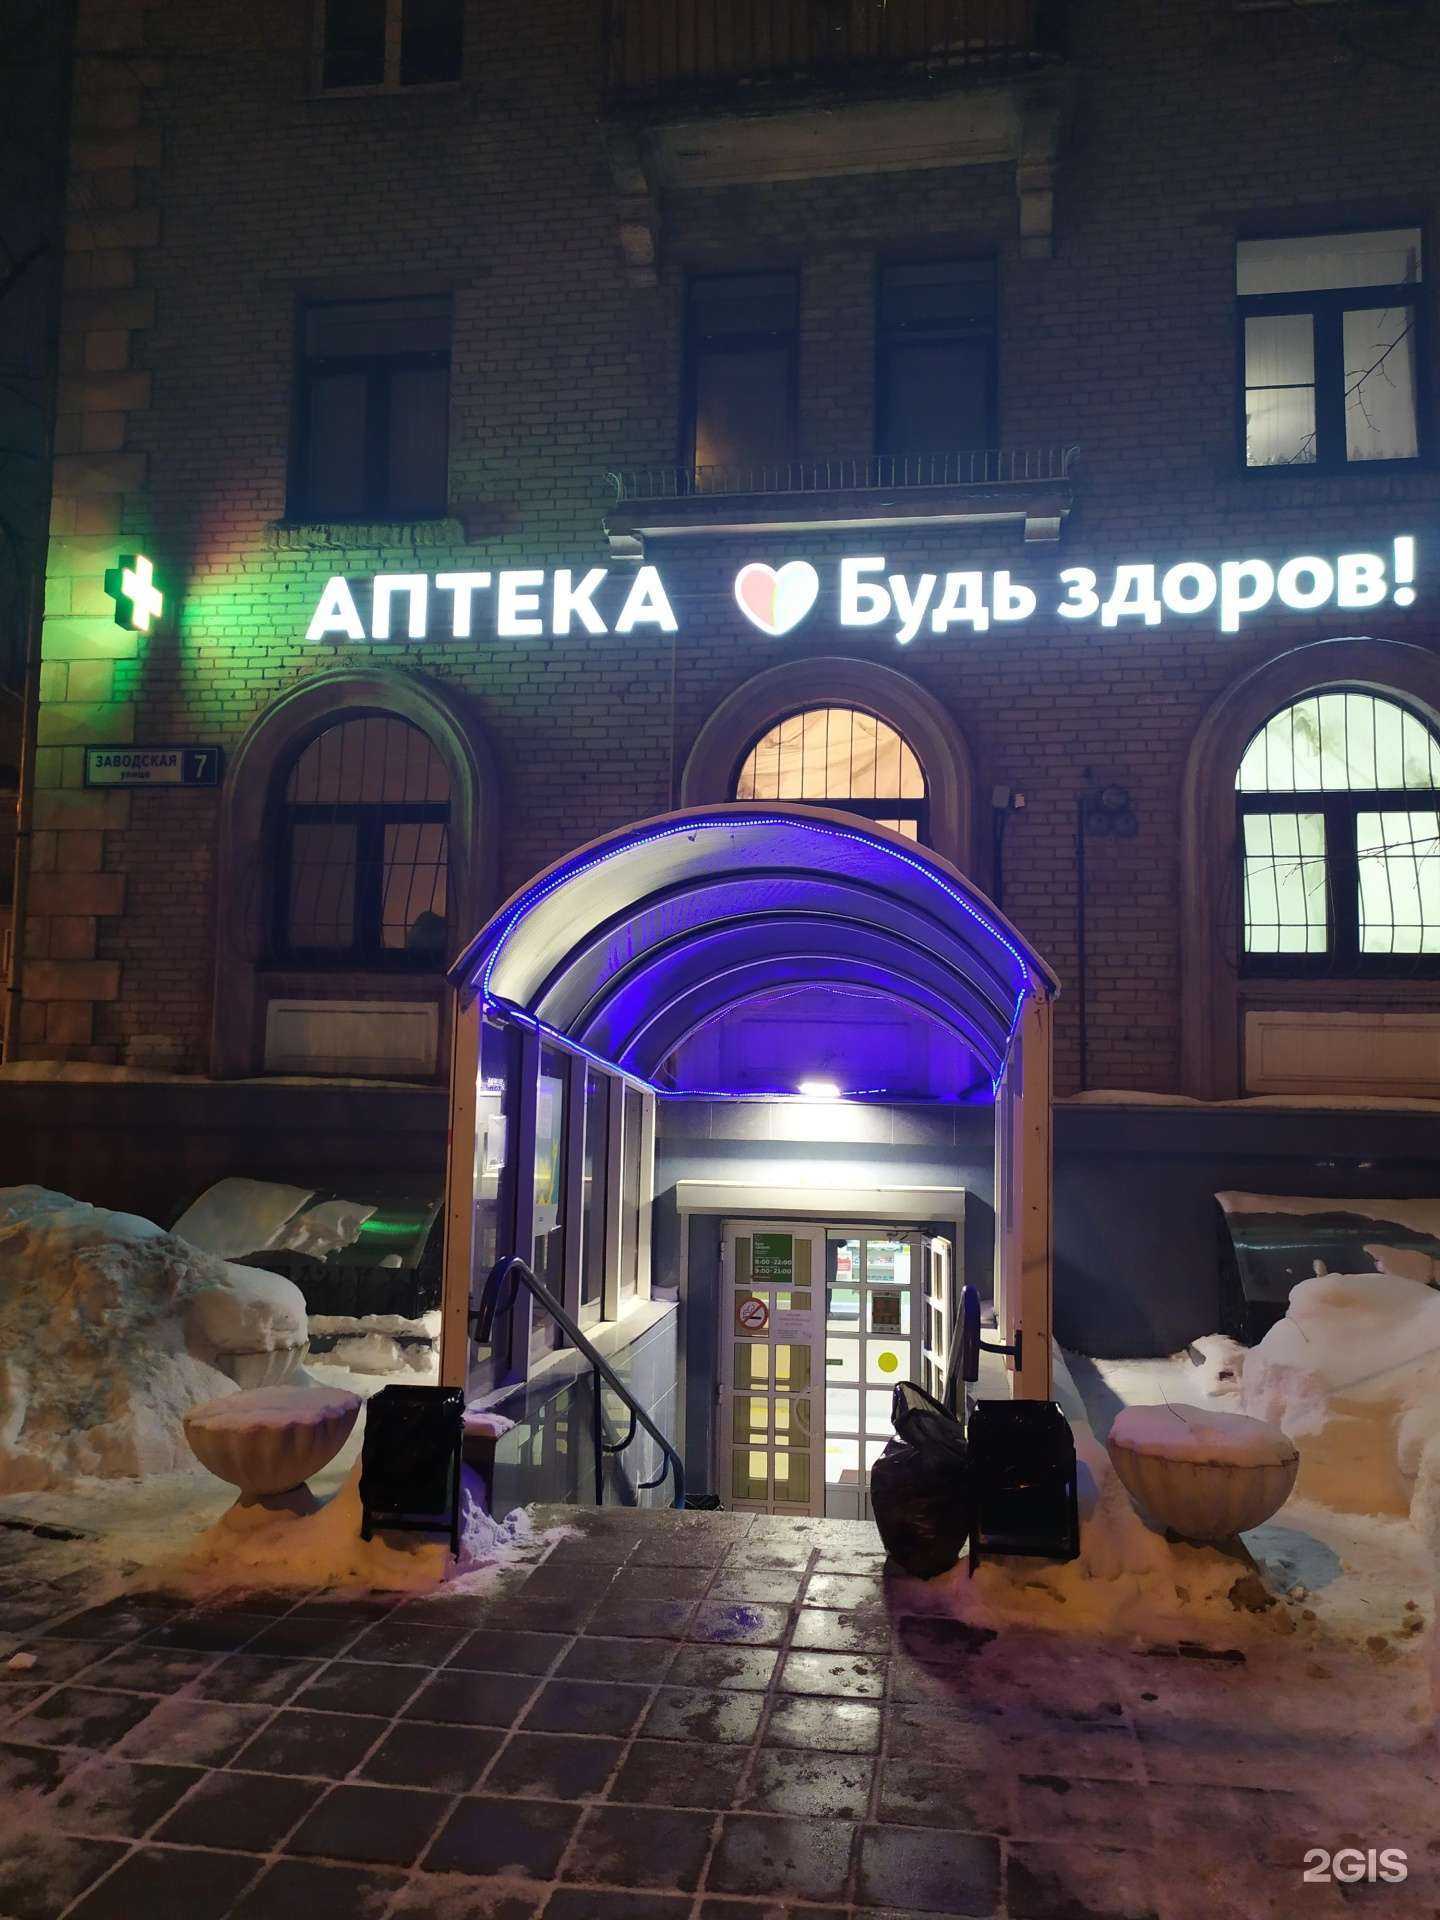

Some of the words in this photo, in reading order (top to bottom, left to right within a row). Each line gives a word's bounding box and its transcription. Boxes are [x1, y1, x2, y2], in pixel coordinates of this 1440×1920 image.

[305, 565, 679, 641] АПТЕКА
[839, 556, 1038, 645] Будь
[1056, 536, 1416, 632] здоров!
[96, 754, 177, 769] ЗАВОДСКАЯ
[194, 754, 208, 779] 7
